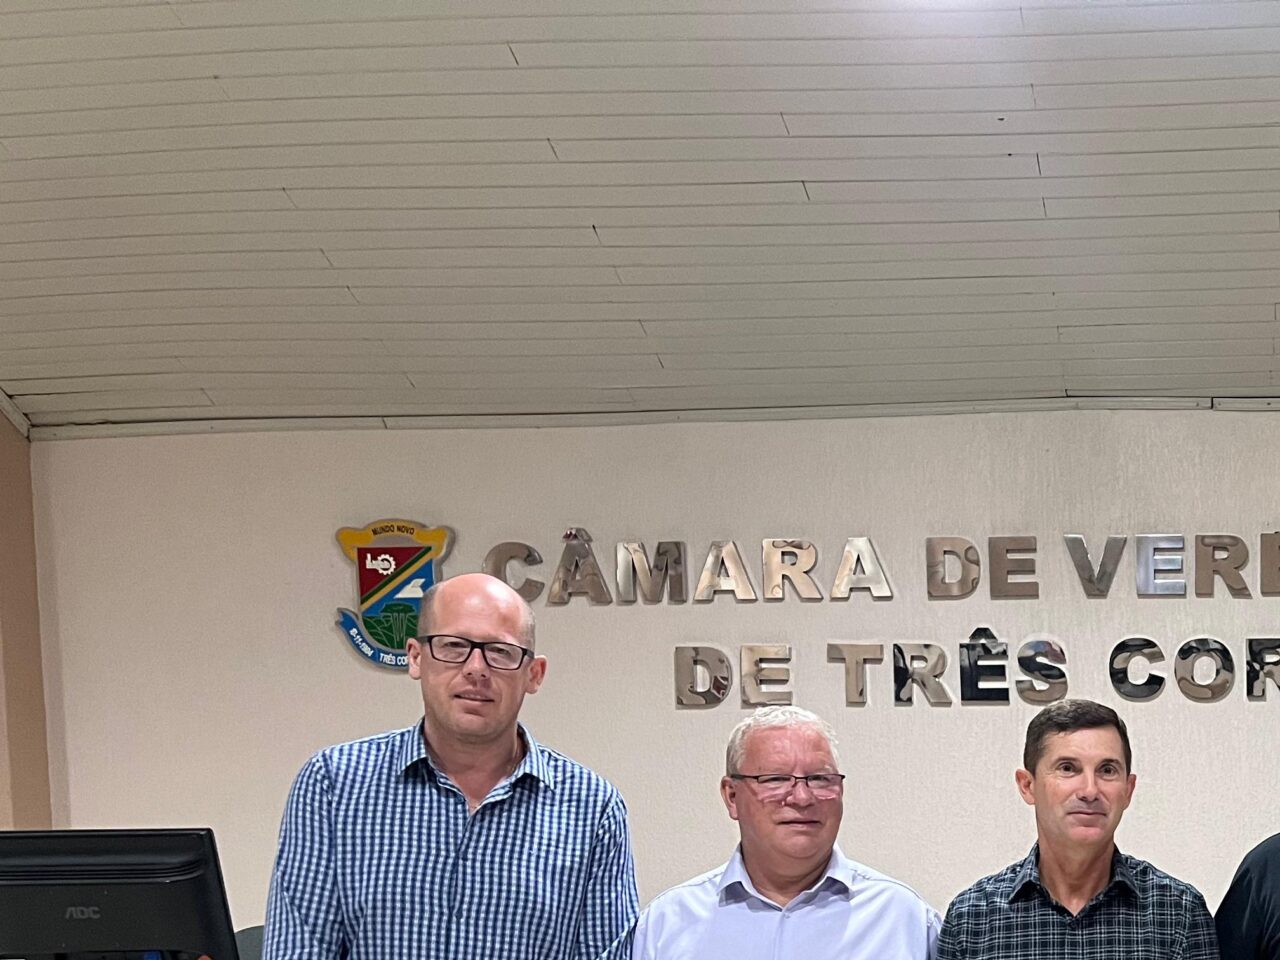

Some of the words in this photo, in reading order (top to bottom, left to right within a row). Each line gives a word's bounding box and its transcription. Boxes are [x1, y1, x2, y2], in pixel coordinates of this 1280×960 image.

[372, 524, 395, 536] MUNDO
[397, 524, 415, 536] NOVO
[482, 527, 893, 605] CÂMARA
[927, 535, 1040, 601] DE
[674, 643, 793, 709] DE
[827, 627, 1068, 708] TRÊS
